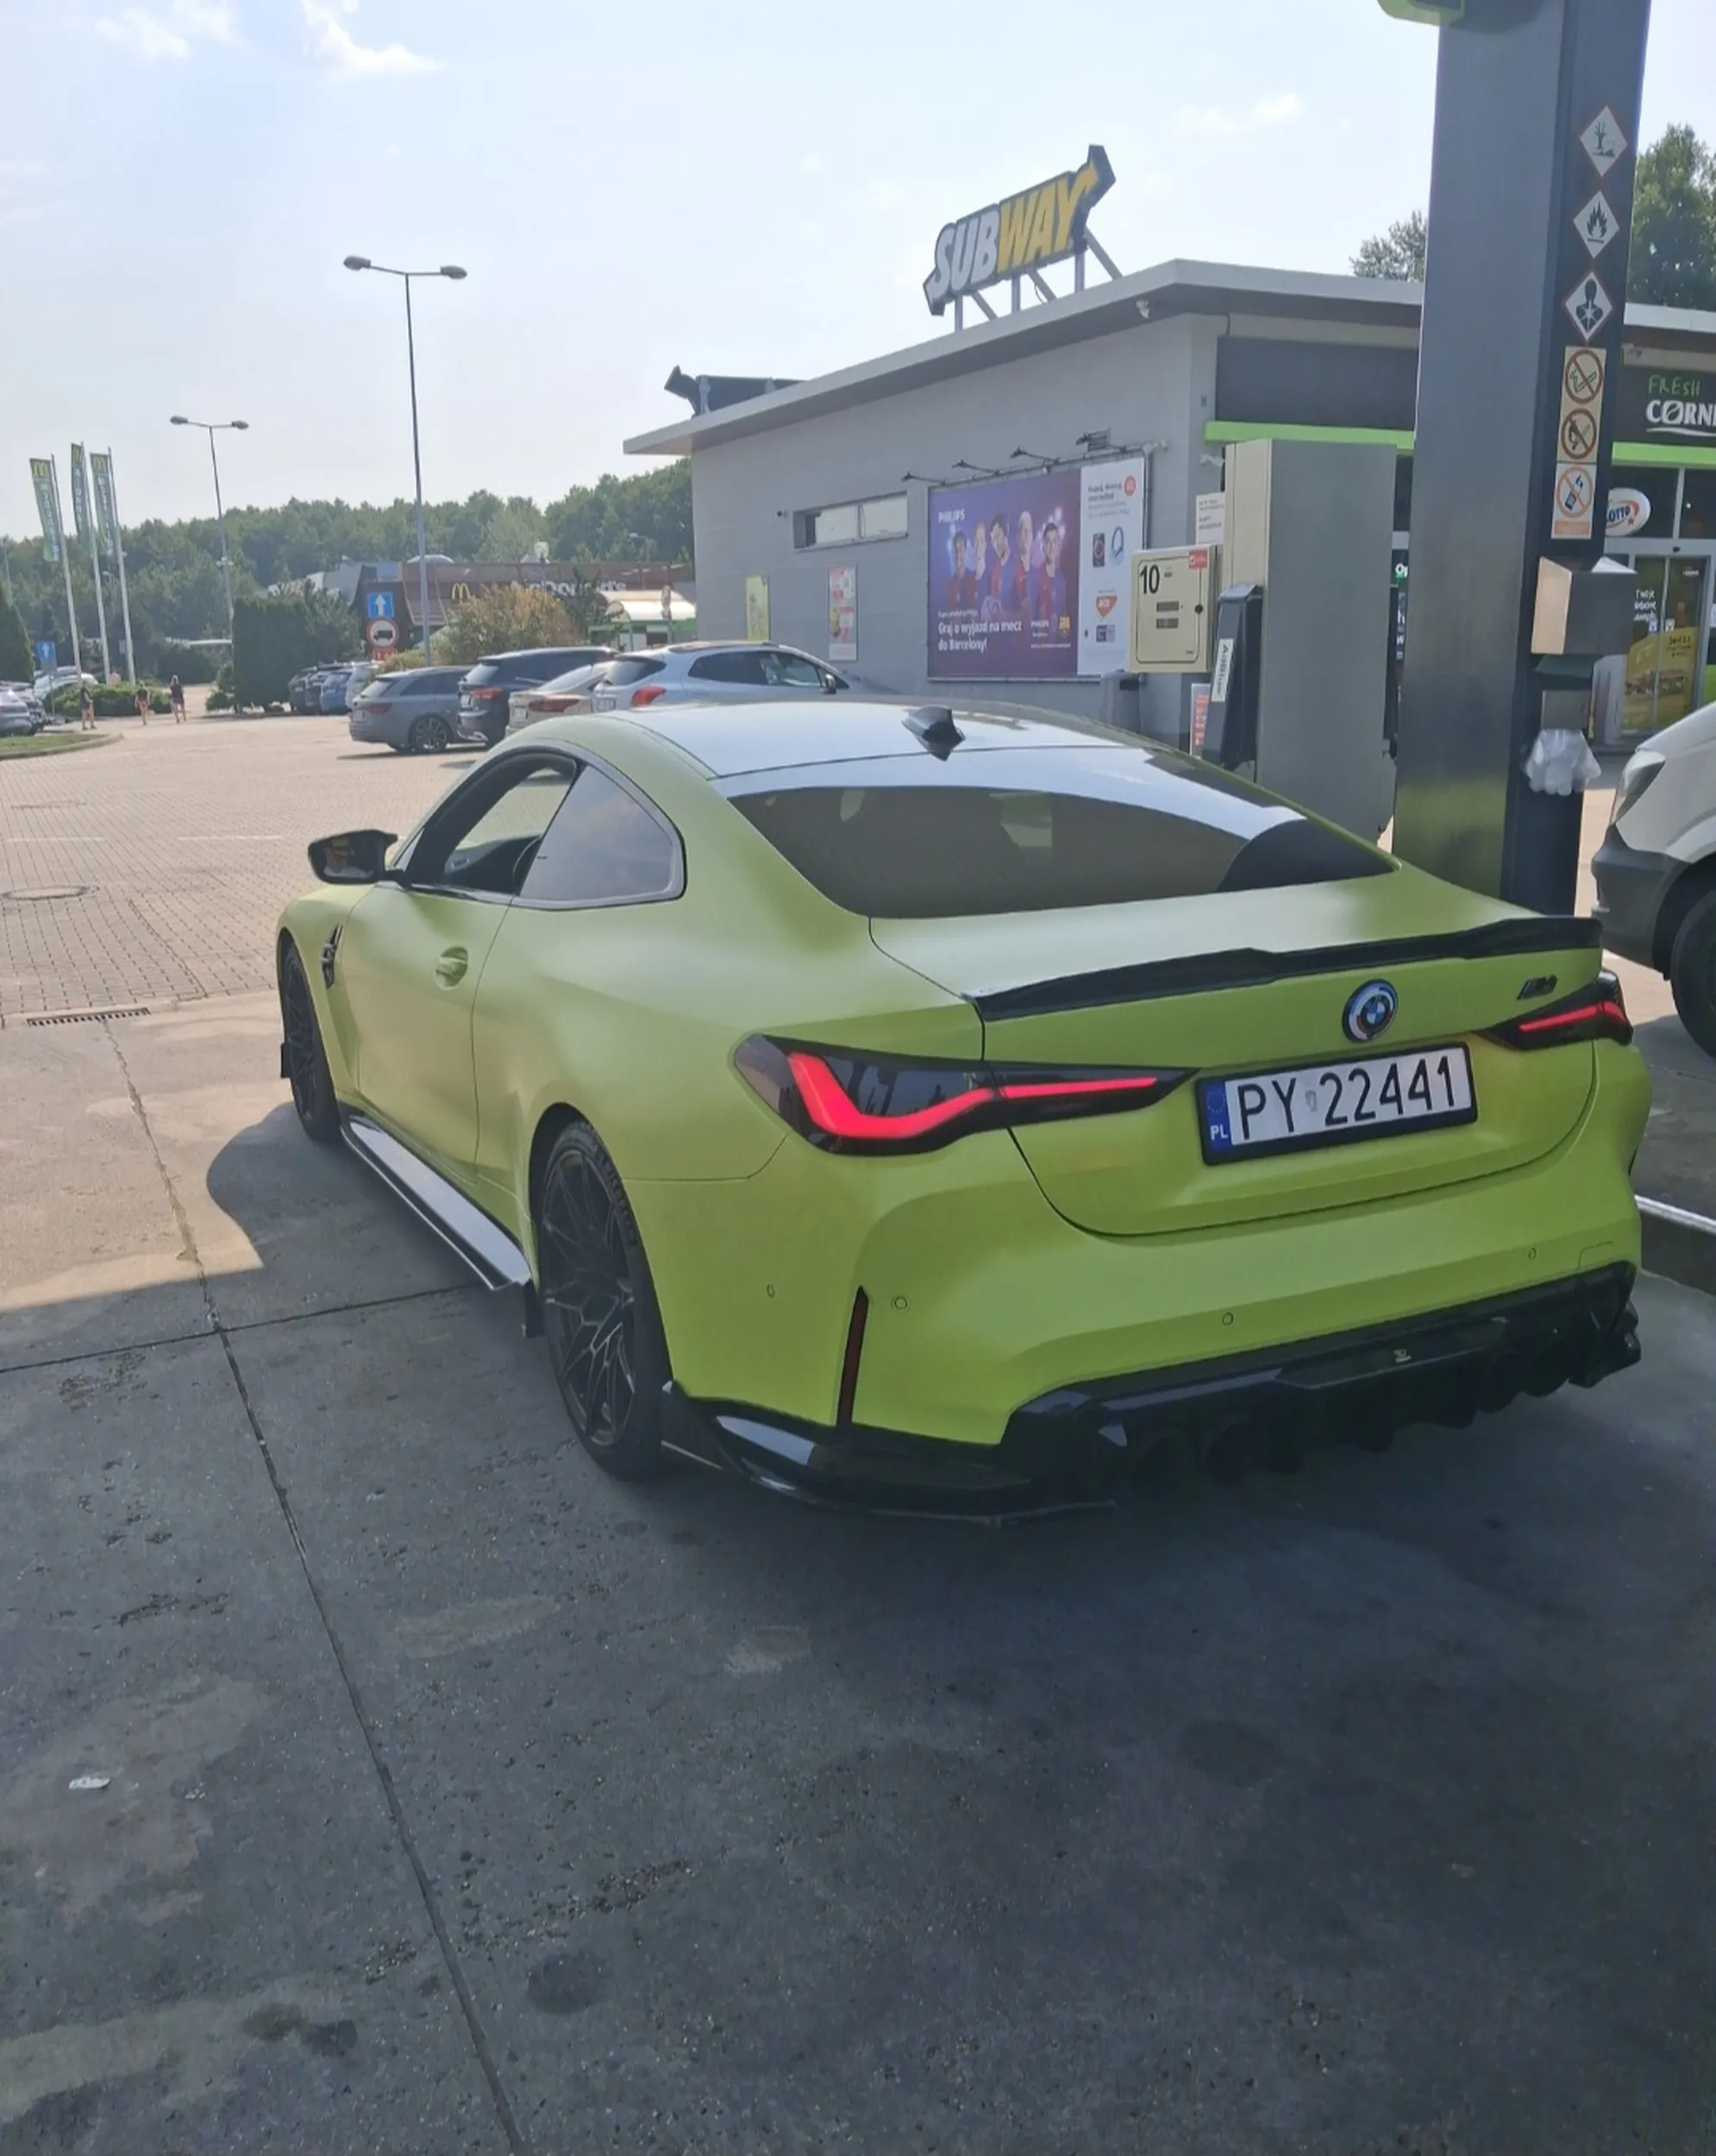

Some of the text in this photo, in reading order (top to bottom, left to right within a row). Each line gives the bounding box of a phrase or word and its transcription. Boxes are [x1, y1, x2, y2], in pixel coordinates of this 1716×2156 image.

[924, 155, 1100, 304] SUBWAY
[1648, 374, 1700, 397] FRESH
[1606, 505, 1631, 523] OTTO
[1139, 565, 1160, 594] 10
[938, 620, 1023, 636] Graj o wyjazd na mecz
[937, 638, 948, 651] do
[1237, 1056, 1456, 1140] PY 22441
[1210, 1124, 1229, 1142] PL
